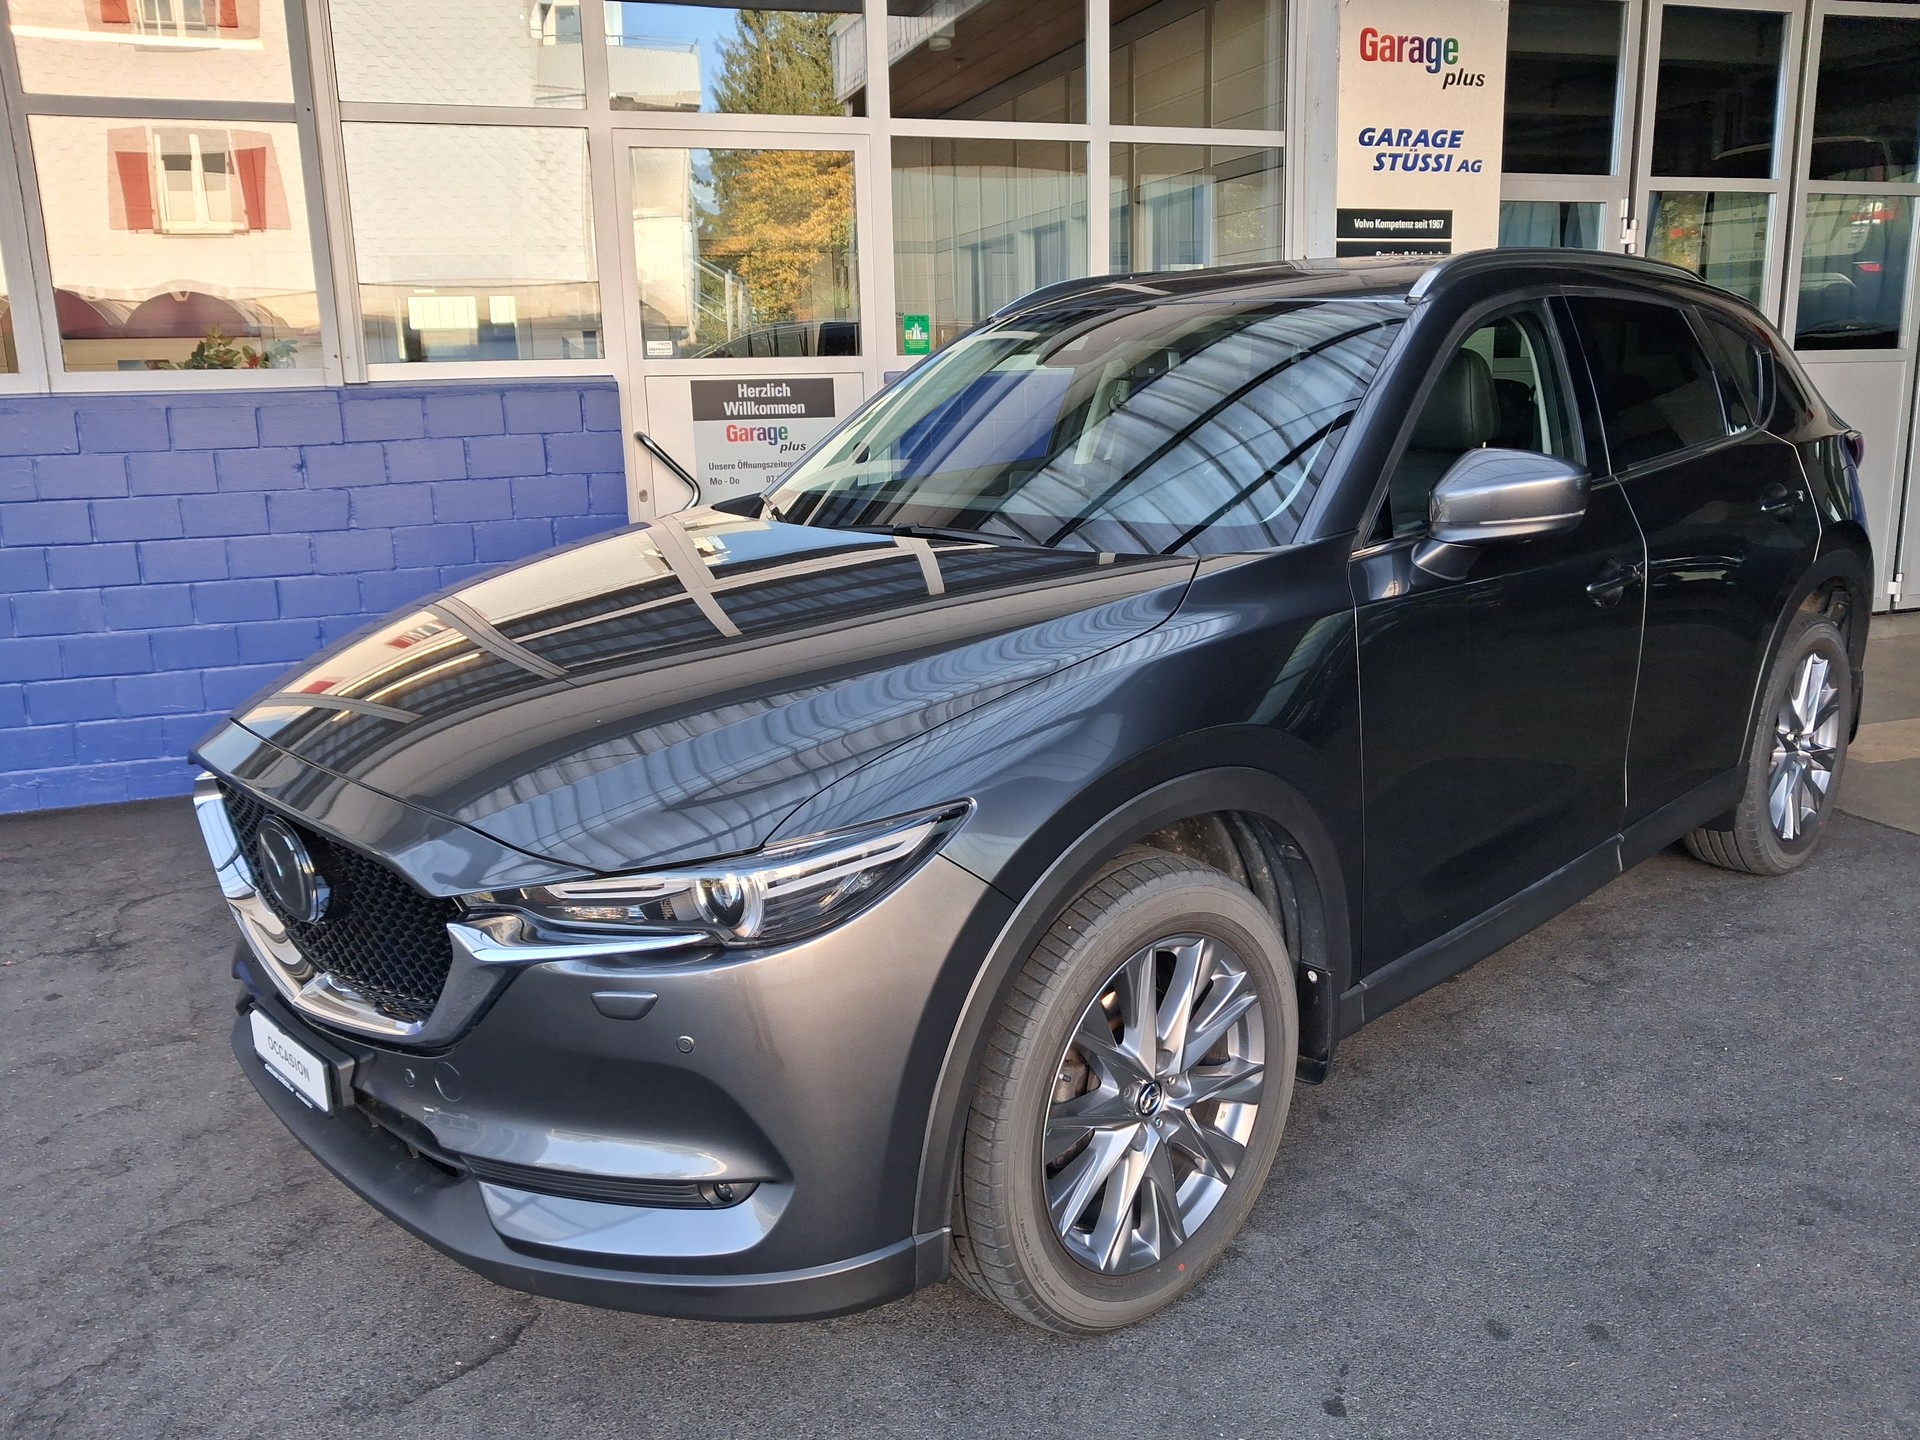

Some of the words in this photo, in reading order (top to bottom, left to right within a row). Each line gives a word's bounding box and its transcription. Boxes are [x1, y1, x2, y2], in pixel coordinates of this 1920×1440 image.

[1360, 27, 1459, 74] Garage
[1442, 68, 1486, 90] plus
[1358, 128, 1464, 148] GARAGE
[1373, 149, 1453, 172] STÜSSI
[1456, 159, 1483, 173] AG
[1354, 218, 1374, 229] Volvo
[1375, 218, 1413, 231] Kompetenz
[1414, 219, 1428, 229] seit
[1429, 219, 1444, 229] 1967
[737, 383, 791, 398] Herzlich
[723, 400, 806, 416] Willkommen
[726, 424, 789, 446] Garage
[779, 441, 807, 454] plus
[708, 462, 736, 470] Unsere
[709, 477, 723, 485] Mo
[729, 476, 740, 485] Do
[267, 1036, 311, 1082] OCCASION
